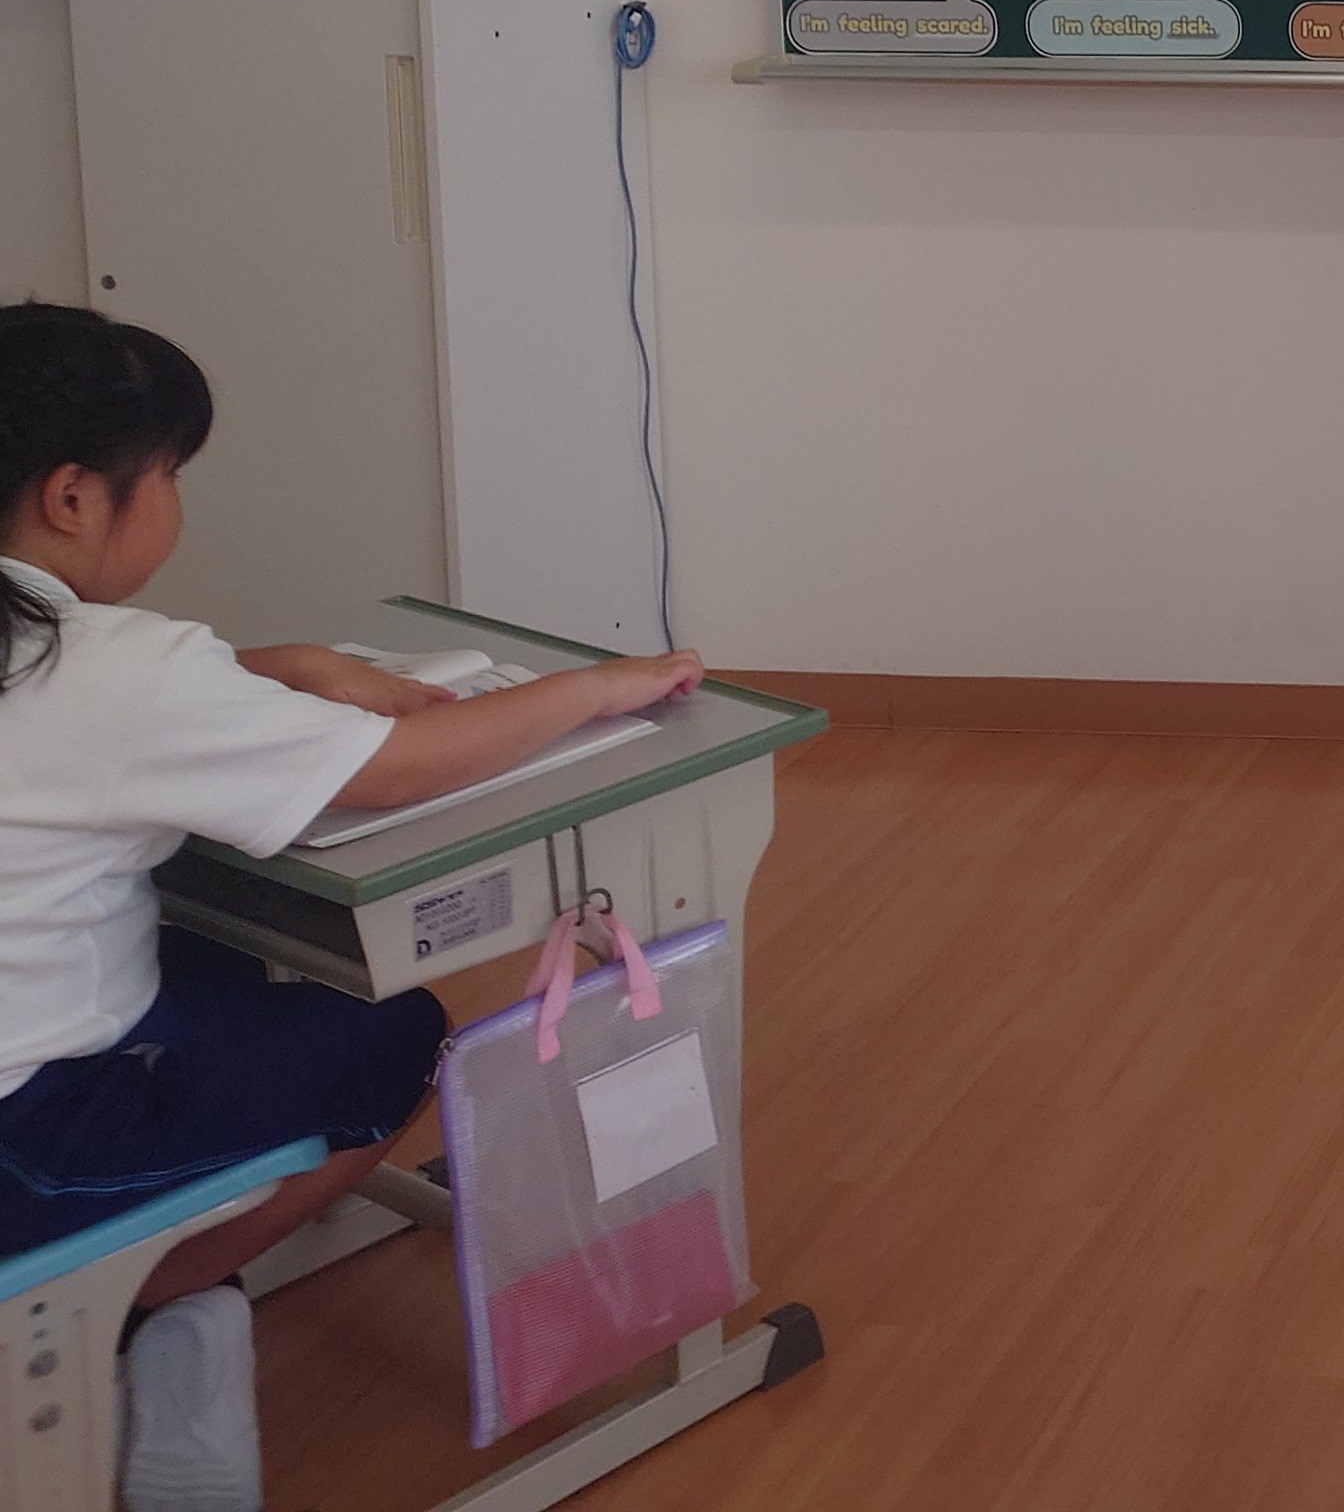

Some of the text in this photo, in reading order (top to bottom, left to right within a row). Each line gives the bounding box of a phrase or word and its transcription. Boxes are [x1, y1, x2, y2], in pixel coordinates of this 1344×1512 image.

[800, 14, 989, 38] I'm feeling scared.
[1051, 17, 1215, 40] I'm feeling sick.
[1301, 22, 1332, 39] I'm
